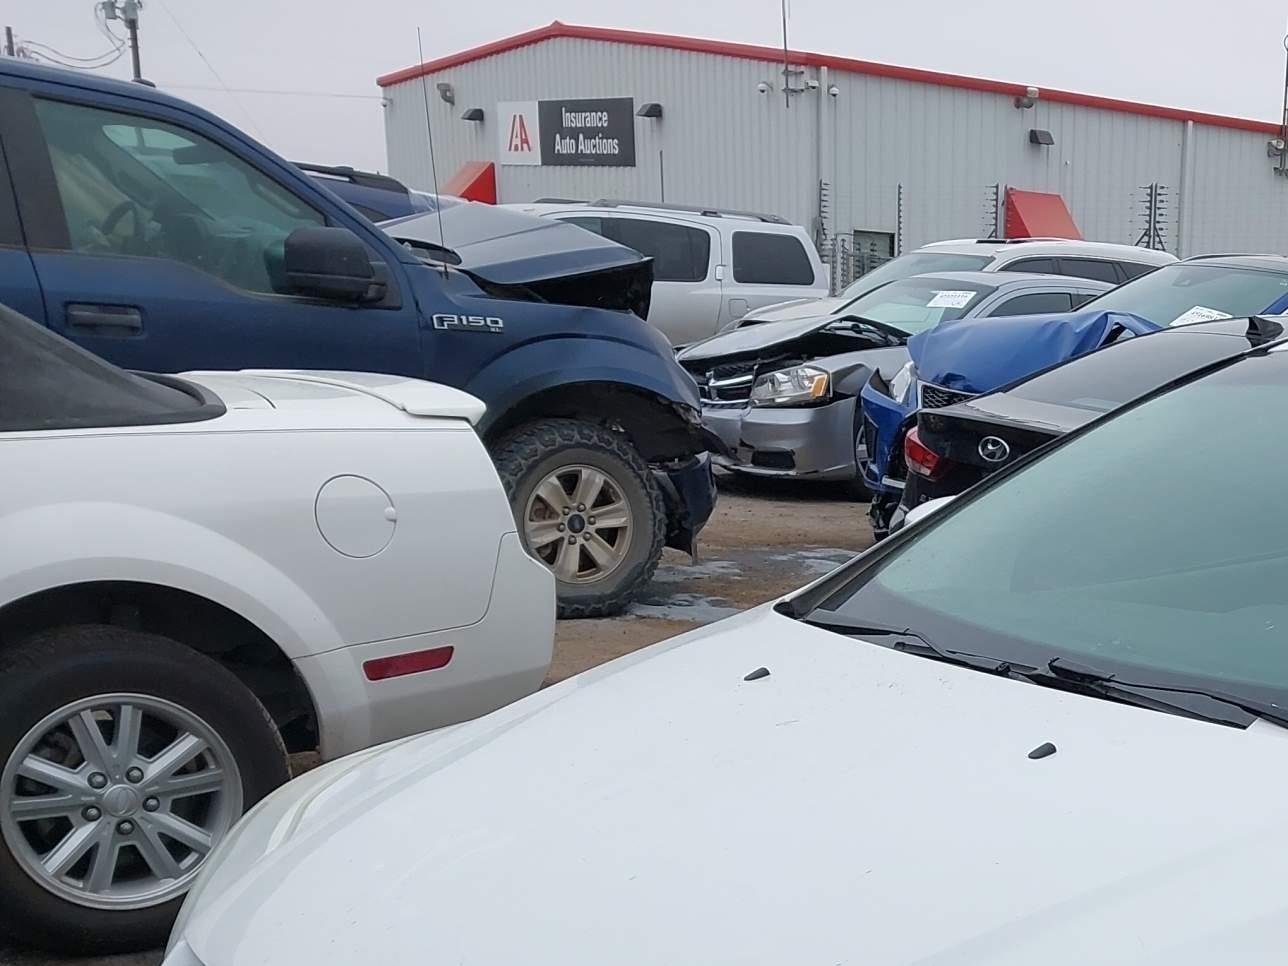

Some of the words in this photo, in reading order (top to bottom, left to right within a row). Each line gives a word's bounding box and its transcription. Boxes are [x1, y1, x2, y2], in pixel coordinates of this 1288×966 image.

[562, 107, 608, 128] Insurance
[555, 133, 576, 154] Auto
[578, 133, 619, 154] Auctions
